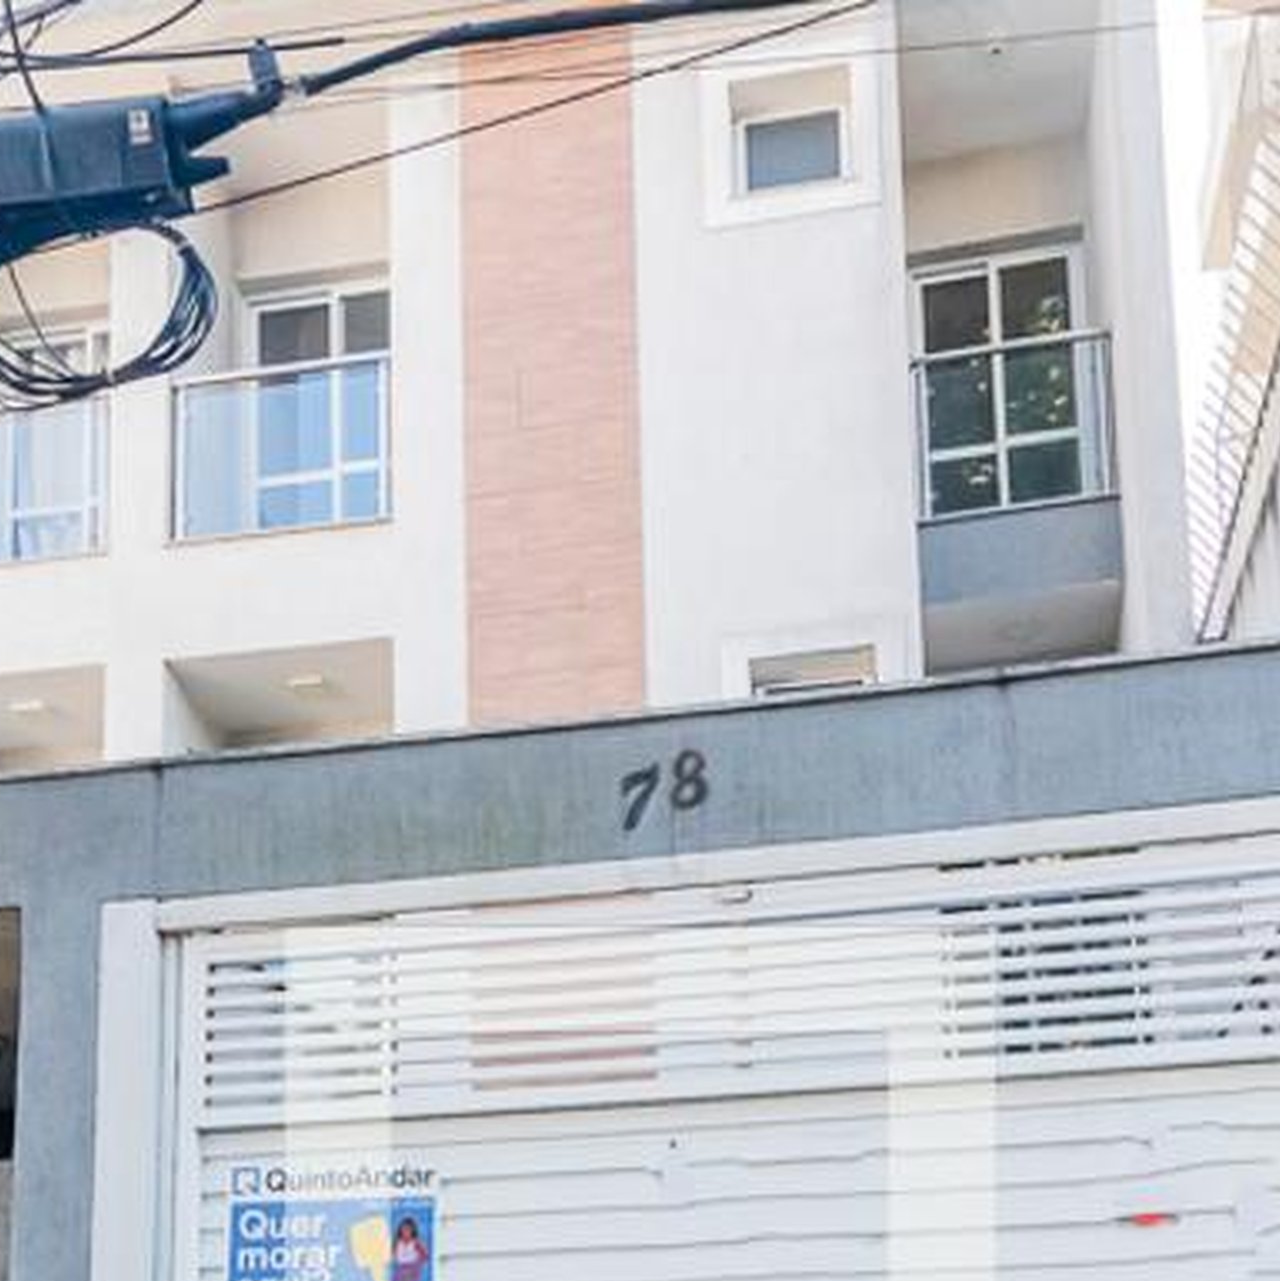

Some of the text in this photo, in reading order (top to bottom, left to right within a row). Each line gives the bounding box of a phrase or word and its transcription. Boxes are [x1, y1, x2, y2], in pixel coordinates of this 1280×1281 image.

[621, 749, 708, 831] 78
[266, 1166, 437, 1192] QuintoAndar
[239, 1210, 326, 1241] Quer
[238, 1245, 342, 1271] morar
